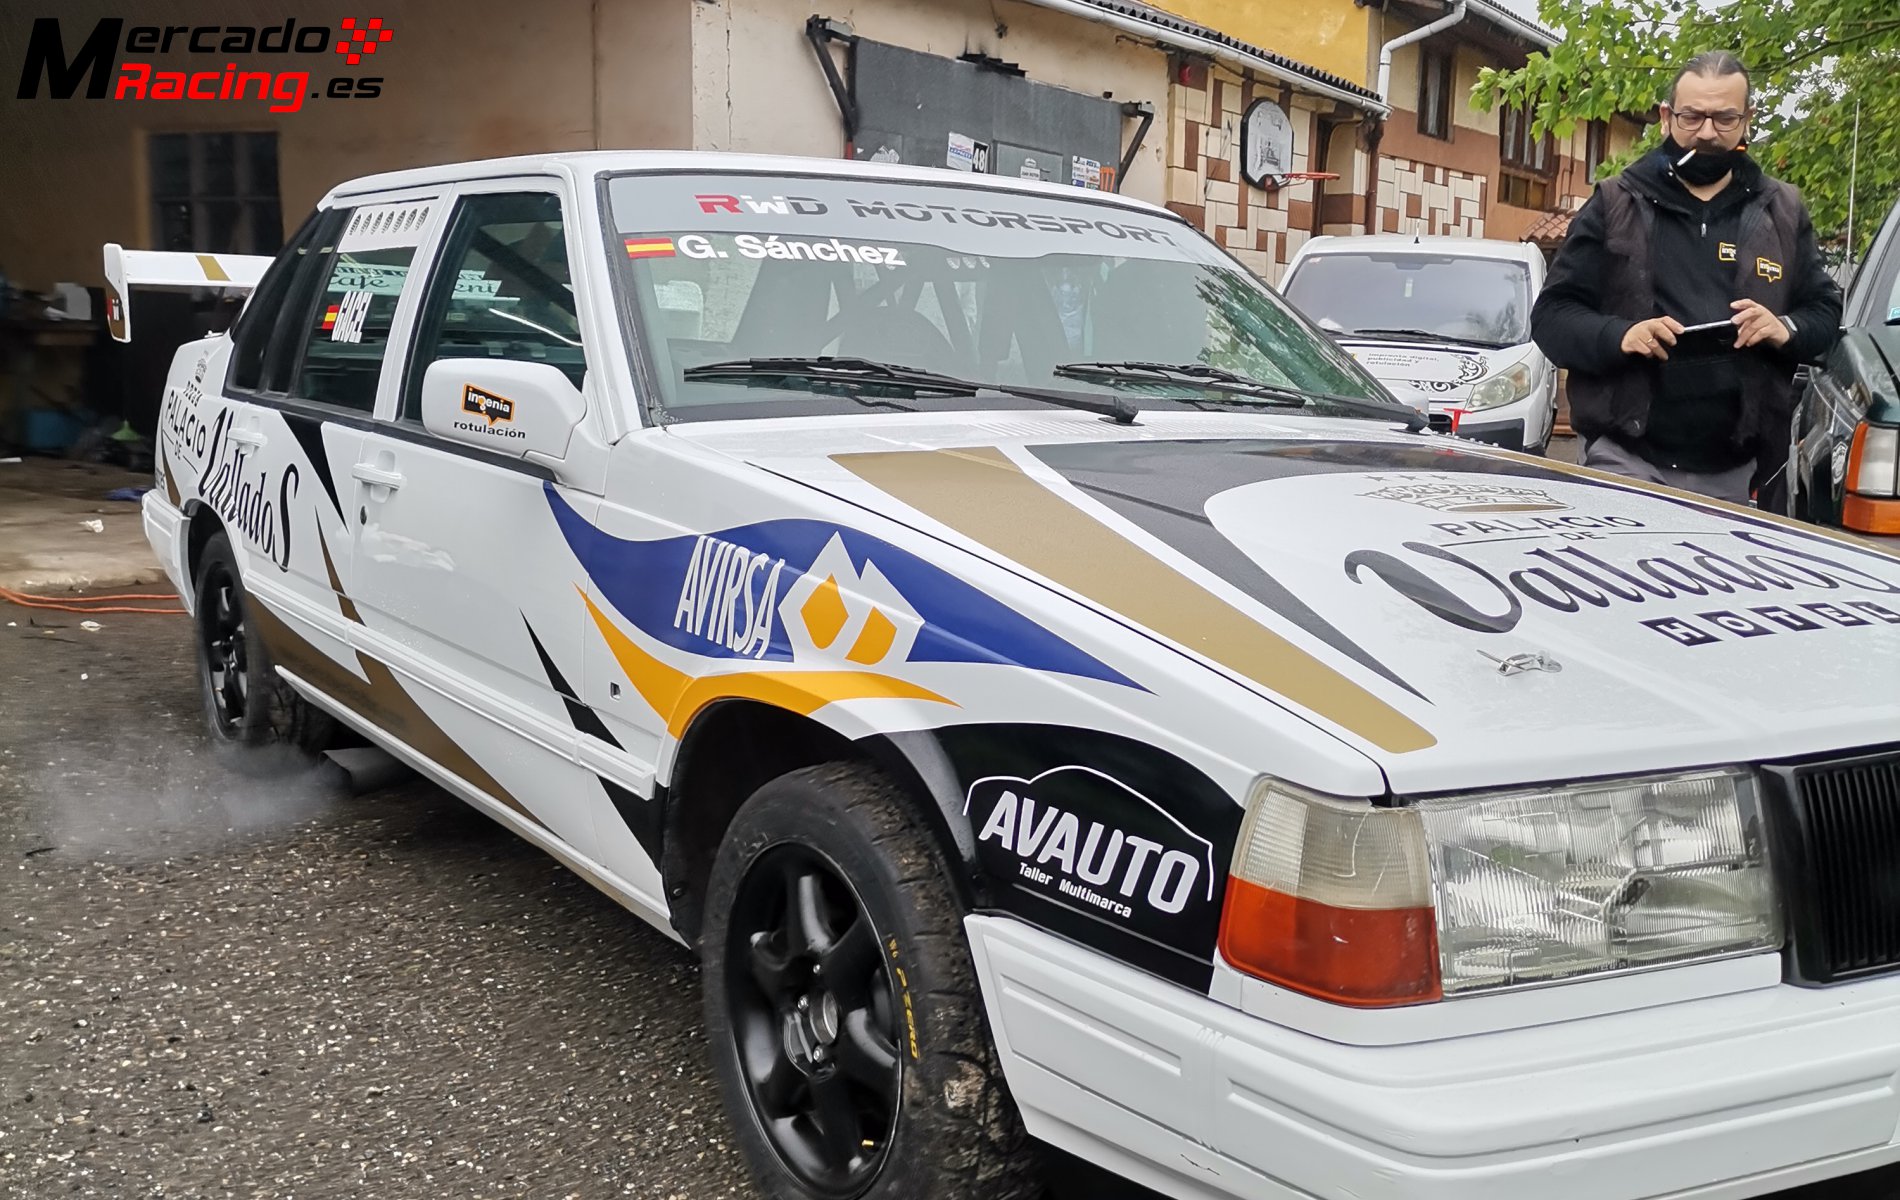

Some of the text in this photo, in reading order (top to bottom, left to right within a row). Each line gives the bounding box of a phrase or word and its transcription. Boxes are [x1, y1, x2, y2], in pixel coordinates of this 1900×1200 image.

[694, 194, 1177, 247] RWD MOTORSPORT
[678, 234, 907, 266] G. Sánchez
[467, 387, 510, 413] ingenia
[165, 390, 207, 459] PALACIO
[453, 421, 526, 439] rotulación
[1428, 516, 1645, 537] PALACIO
[1558, 530, 1607, 541] DE
[673, 535, 785, 660] AVIRSA
[978, 790, 1200, 914] AVAUTO
[1018, 862, 1133, 919] Taller Multimarca
